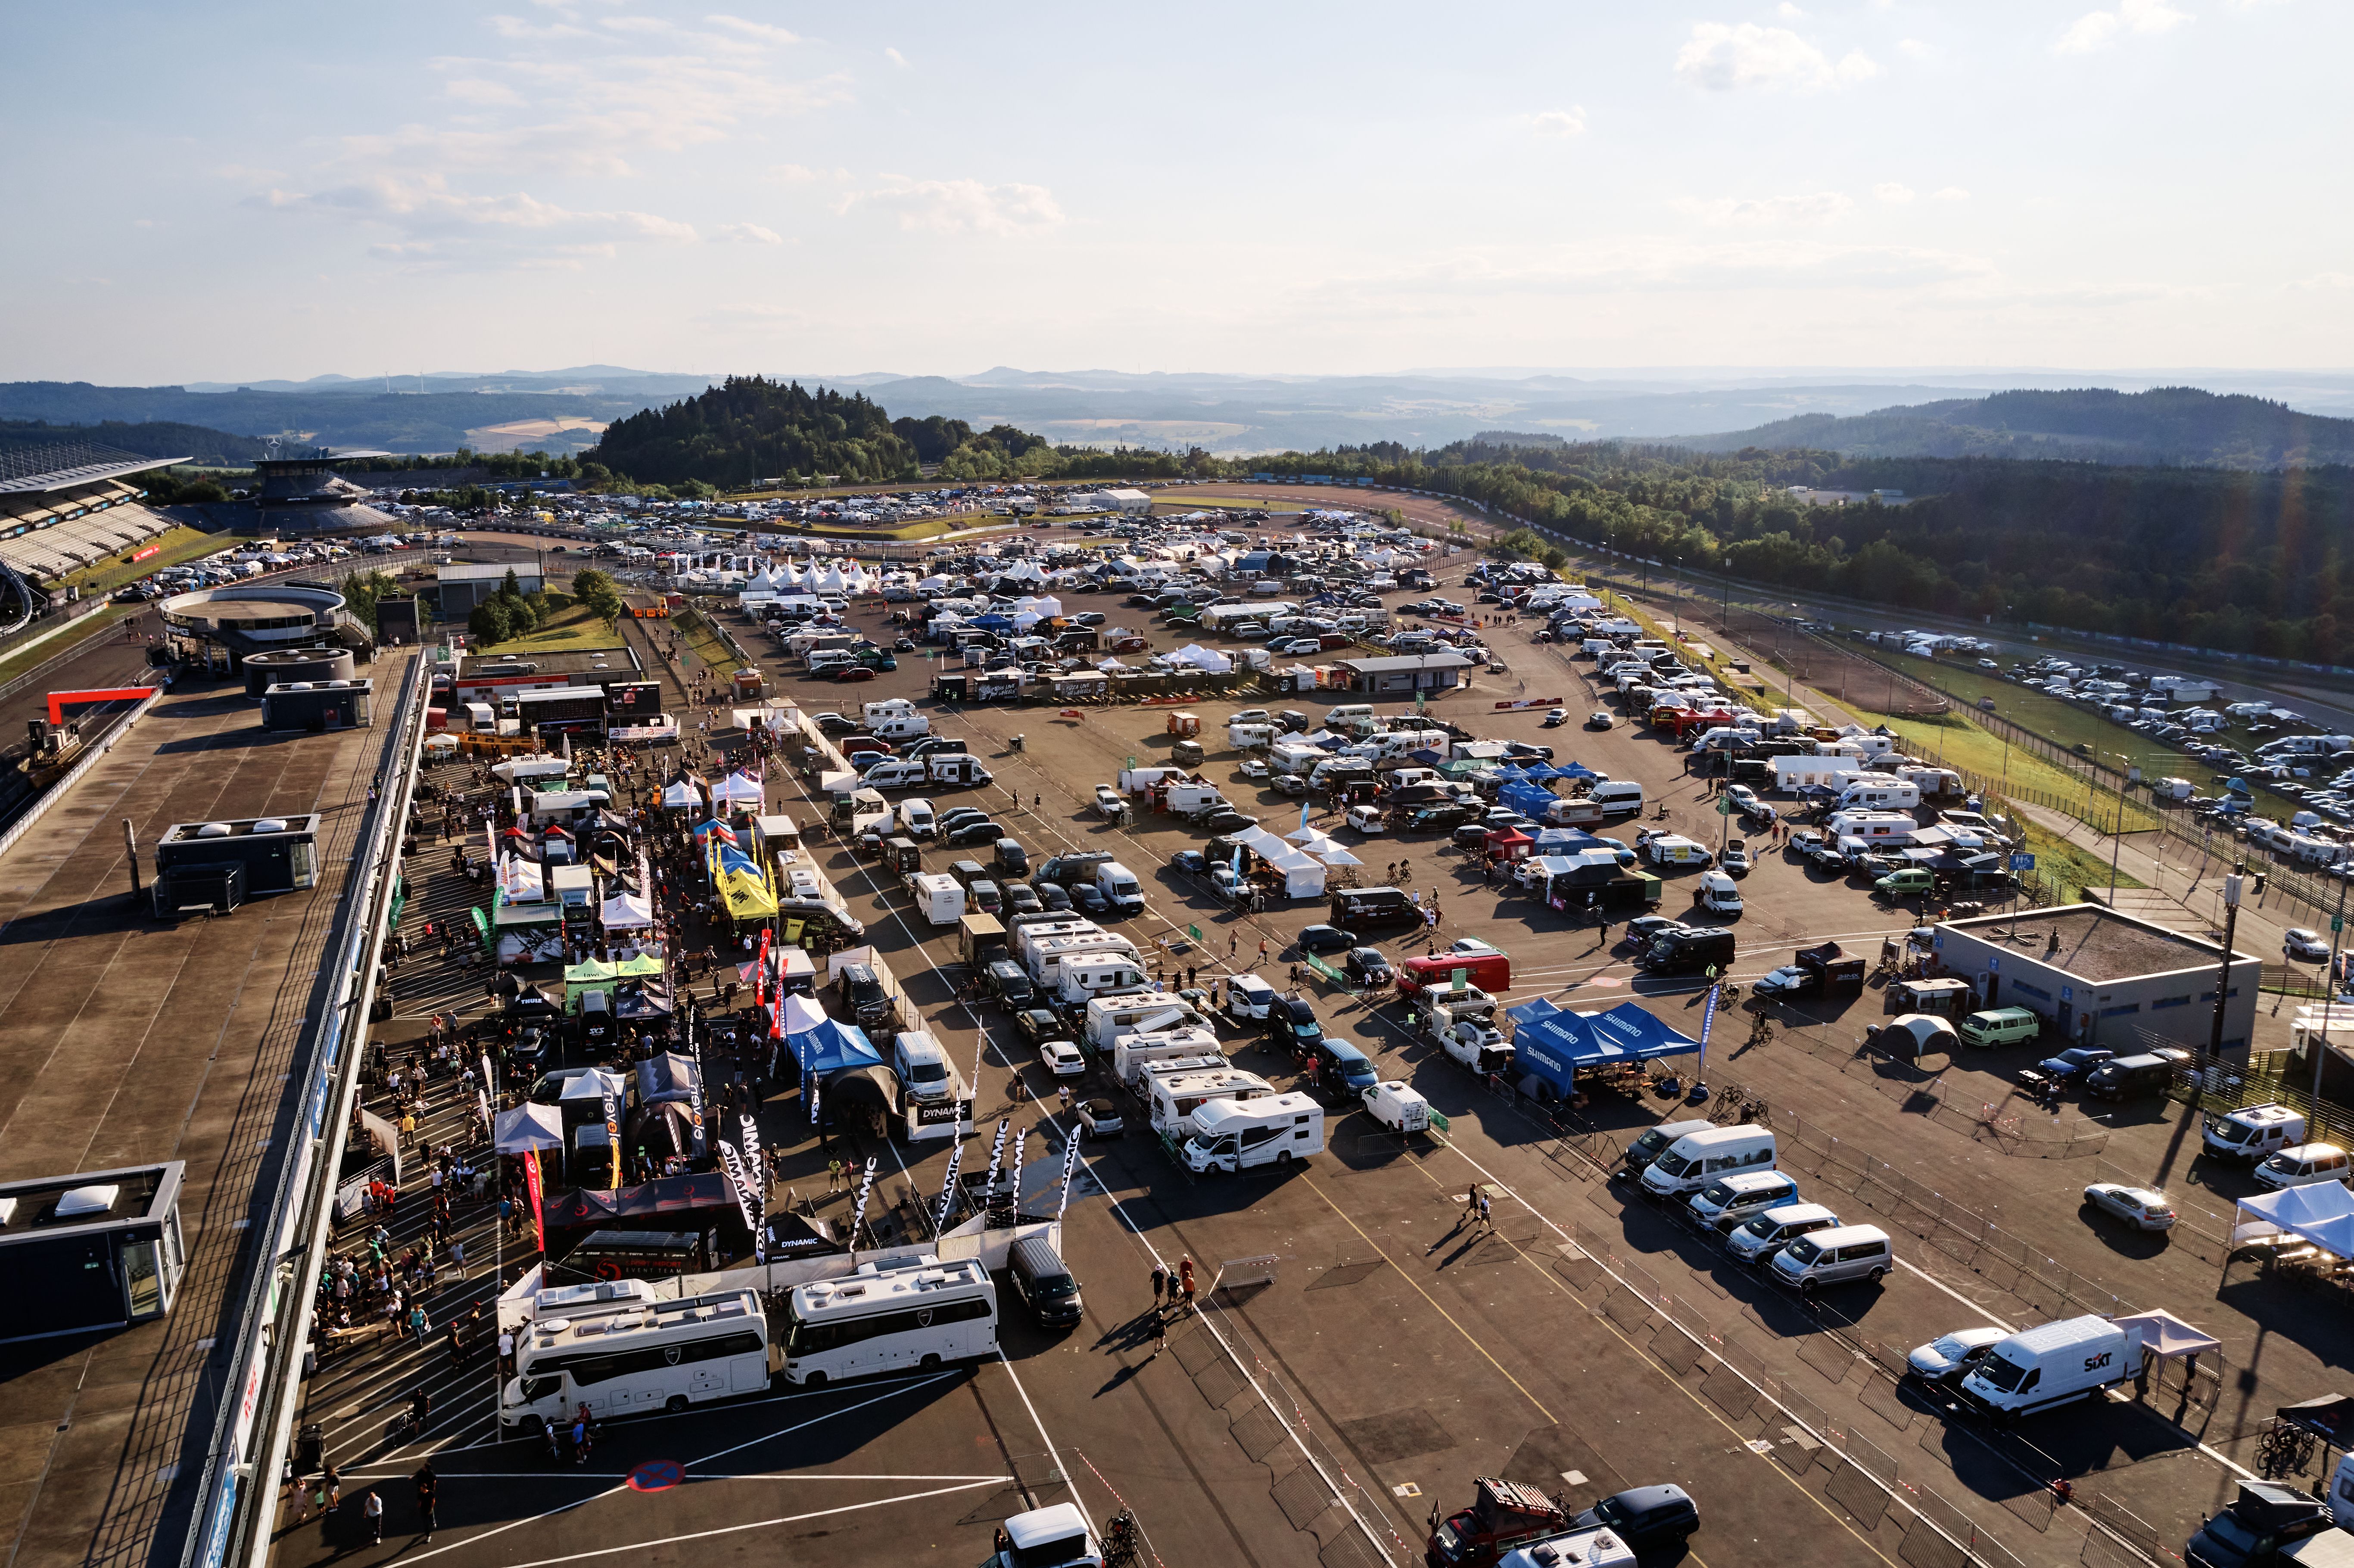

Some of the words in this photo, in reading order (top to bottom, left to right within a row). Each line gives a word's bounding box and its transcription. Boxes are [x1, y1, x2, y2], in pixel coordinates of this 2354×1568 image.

[395, 900, 404, 914] DEKRA
[855, 969, 871, 983] SWISS
[1603, 1013, 1642, 1037] SHIMANO
[1703, 988, 1719, 1043] SHIMANO
[806, 1030, 824, 1055] SHIMANO
[1541, 1020, 1579, 1044] SHIMANO
[1527, 1046, 1561, 1073] SHIMANO
[923, 1104, 966, 1118] DYNAMC
[986, 1120, 1009, 1206] YNAMIC
[1013, 1126, 1026, 1207] YNAMIC
[1061, 1132, 1080, 1202] NAMIC
[939, 1152, 961, 1226] YNAMIC
[782, 1238, 819, 1248] DYNAMIC
[243, 1362, 258, 1425] ROWE
